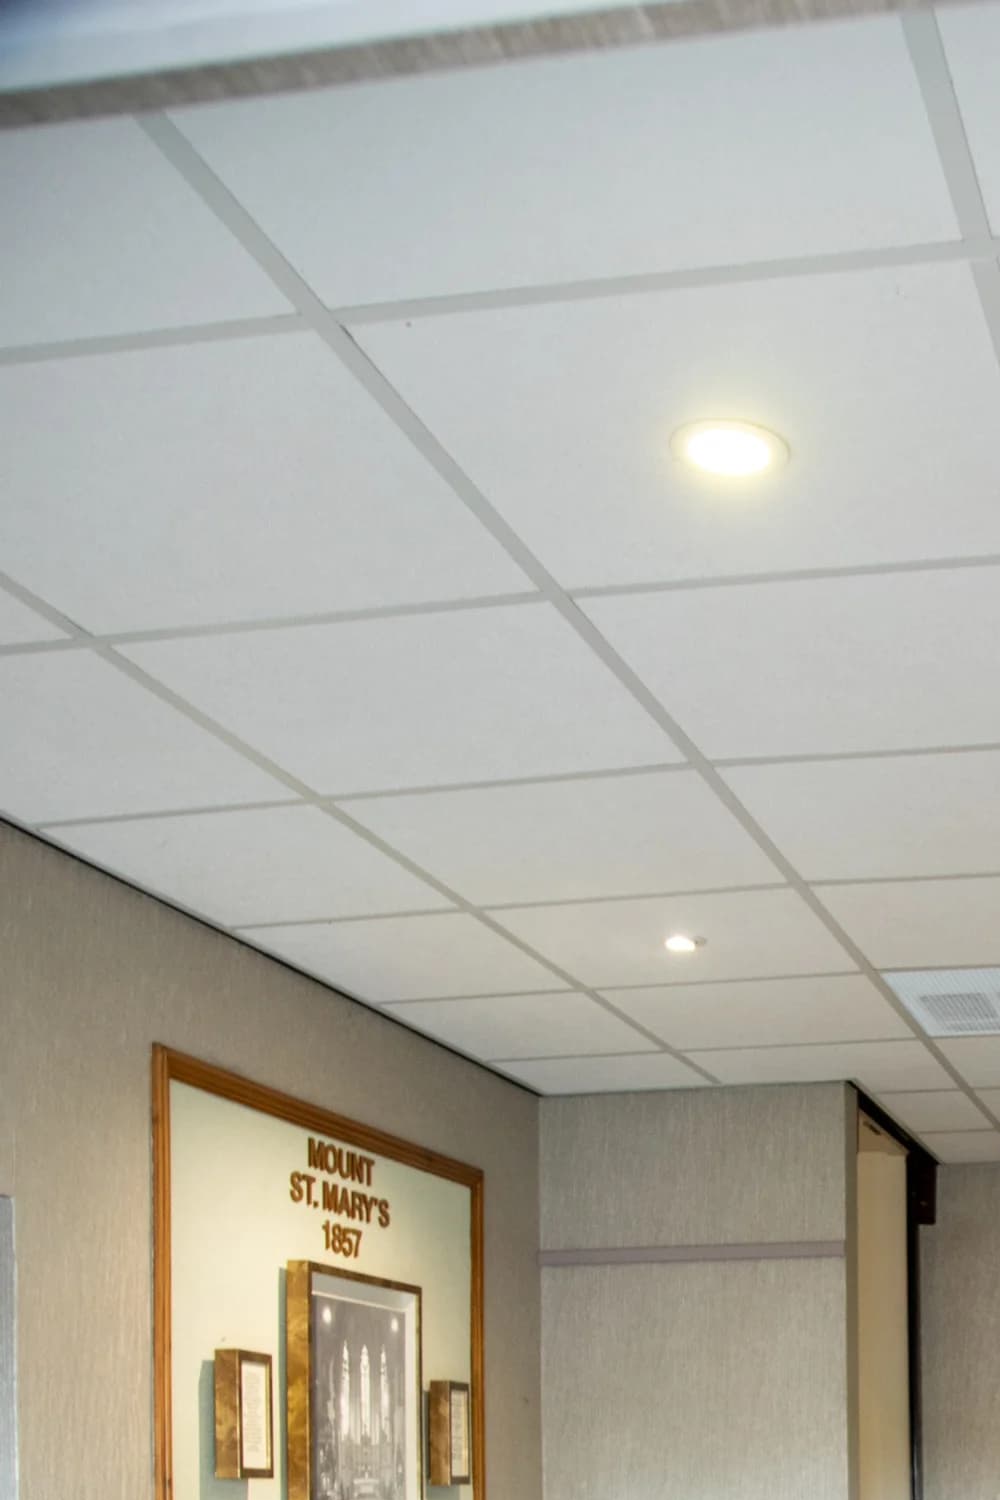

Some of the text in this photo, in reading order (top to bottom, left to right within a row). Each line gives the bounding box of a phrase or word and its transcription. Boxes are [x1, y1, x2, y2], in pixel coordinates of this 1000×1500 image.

[307, 1136, 375, 1187] MOUNT
[289, 1170, 390, 1228] ST. MARY'S
[322, 1219, 362, 1258] 1857
